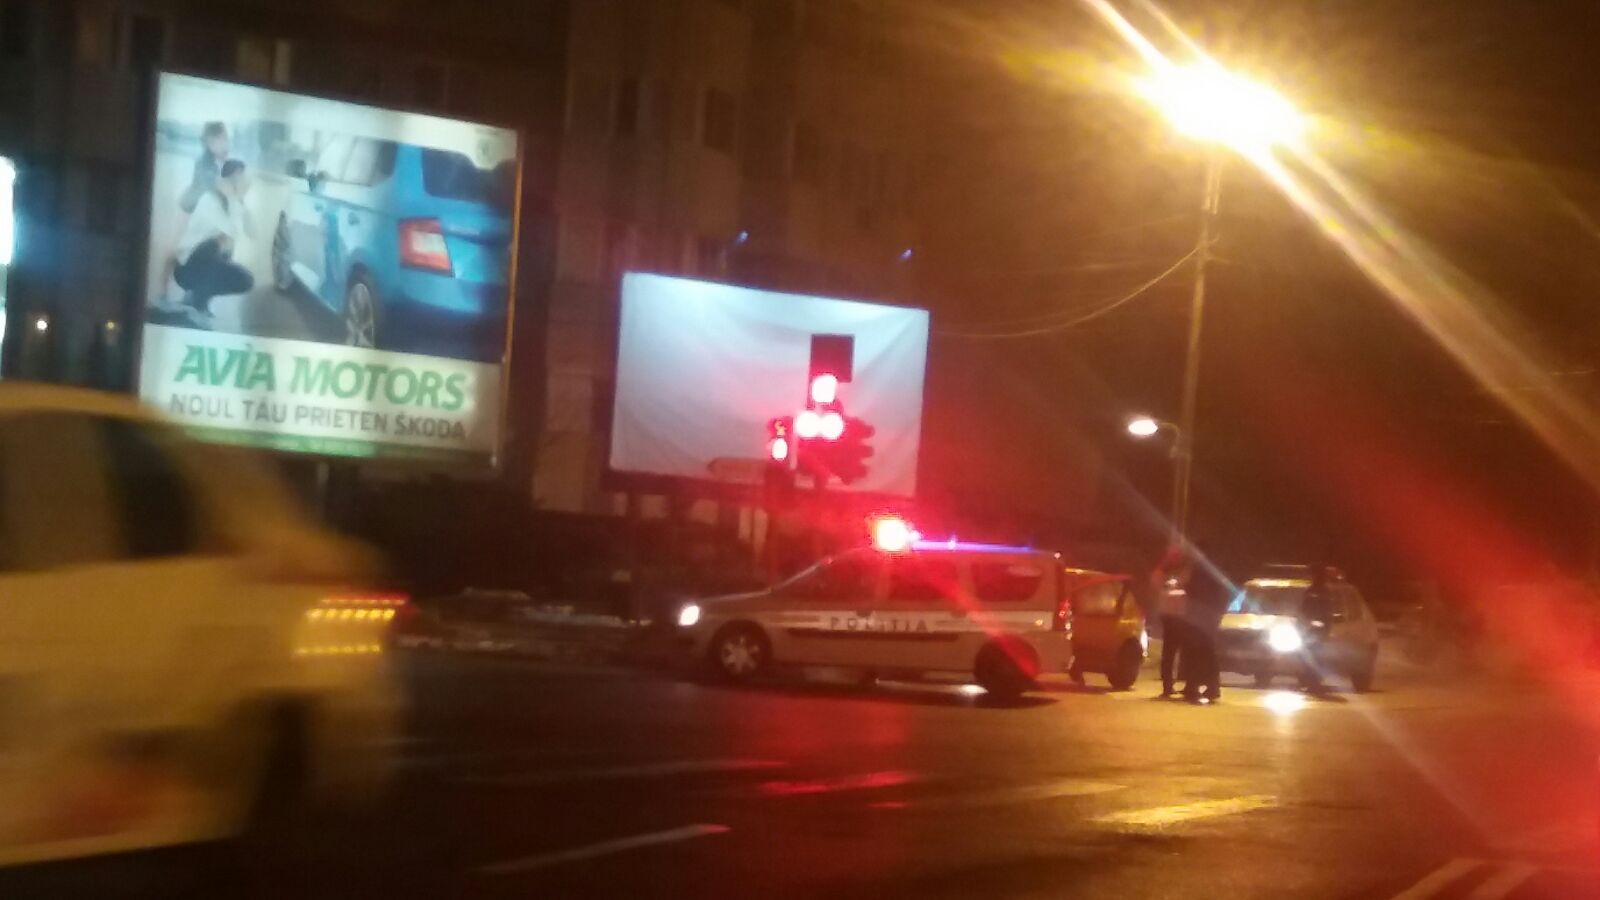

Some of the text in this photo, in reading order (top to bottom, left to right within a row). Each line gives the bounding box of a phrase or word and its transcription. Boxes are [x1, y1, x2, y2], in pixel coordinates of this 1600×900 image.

[289, 355, 467, 412] MOTORS
[169, 393, 233, 419] NOUL
[295, 404, 388, 434] PRIETEN
